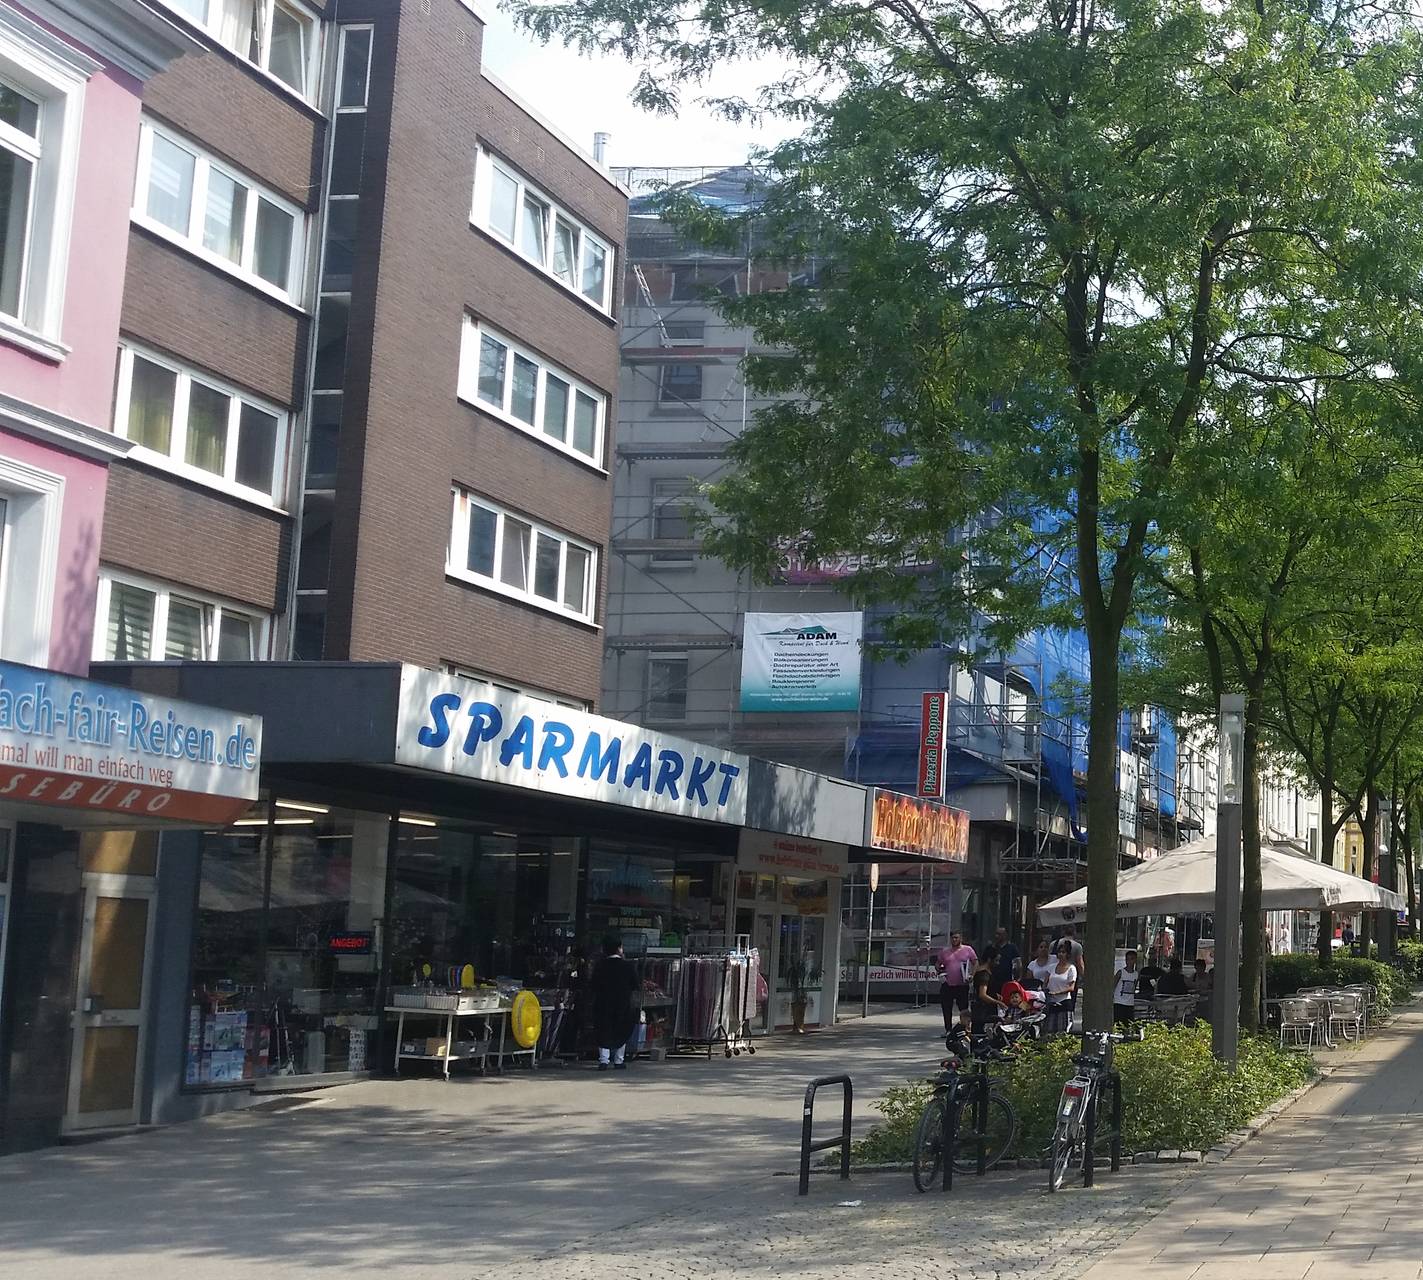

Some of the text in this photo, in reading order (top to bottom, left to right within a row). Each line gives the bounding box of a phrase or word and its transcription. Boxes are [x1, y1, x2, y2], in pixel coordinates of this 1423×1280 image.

[797, 632, 837, 640] ADAM
[0, 674, 257, 771] ach-fair-Reisen.de
[417, 693, 740, 807] SPARMARKT
[923, 696, 941, 793] Pizzeria Peppone
[34, 748, 58, 769] will
[63, 754, 93, 774] man
[99, 757, 144, 781] einfach
[149, 766, 174, 787] weg
[1, 773, 171, 812] SEBÜRO
[329, 938, 369, 948] ANGEBOT
